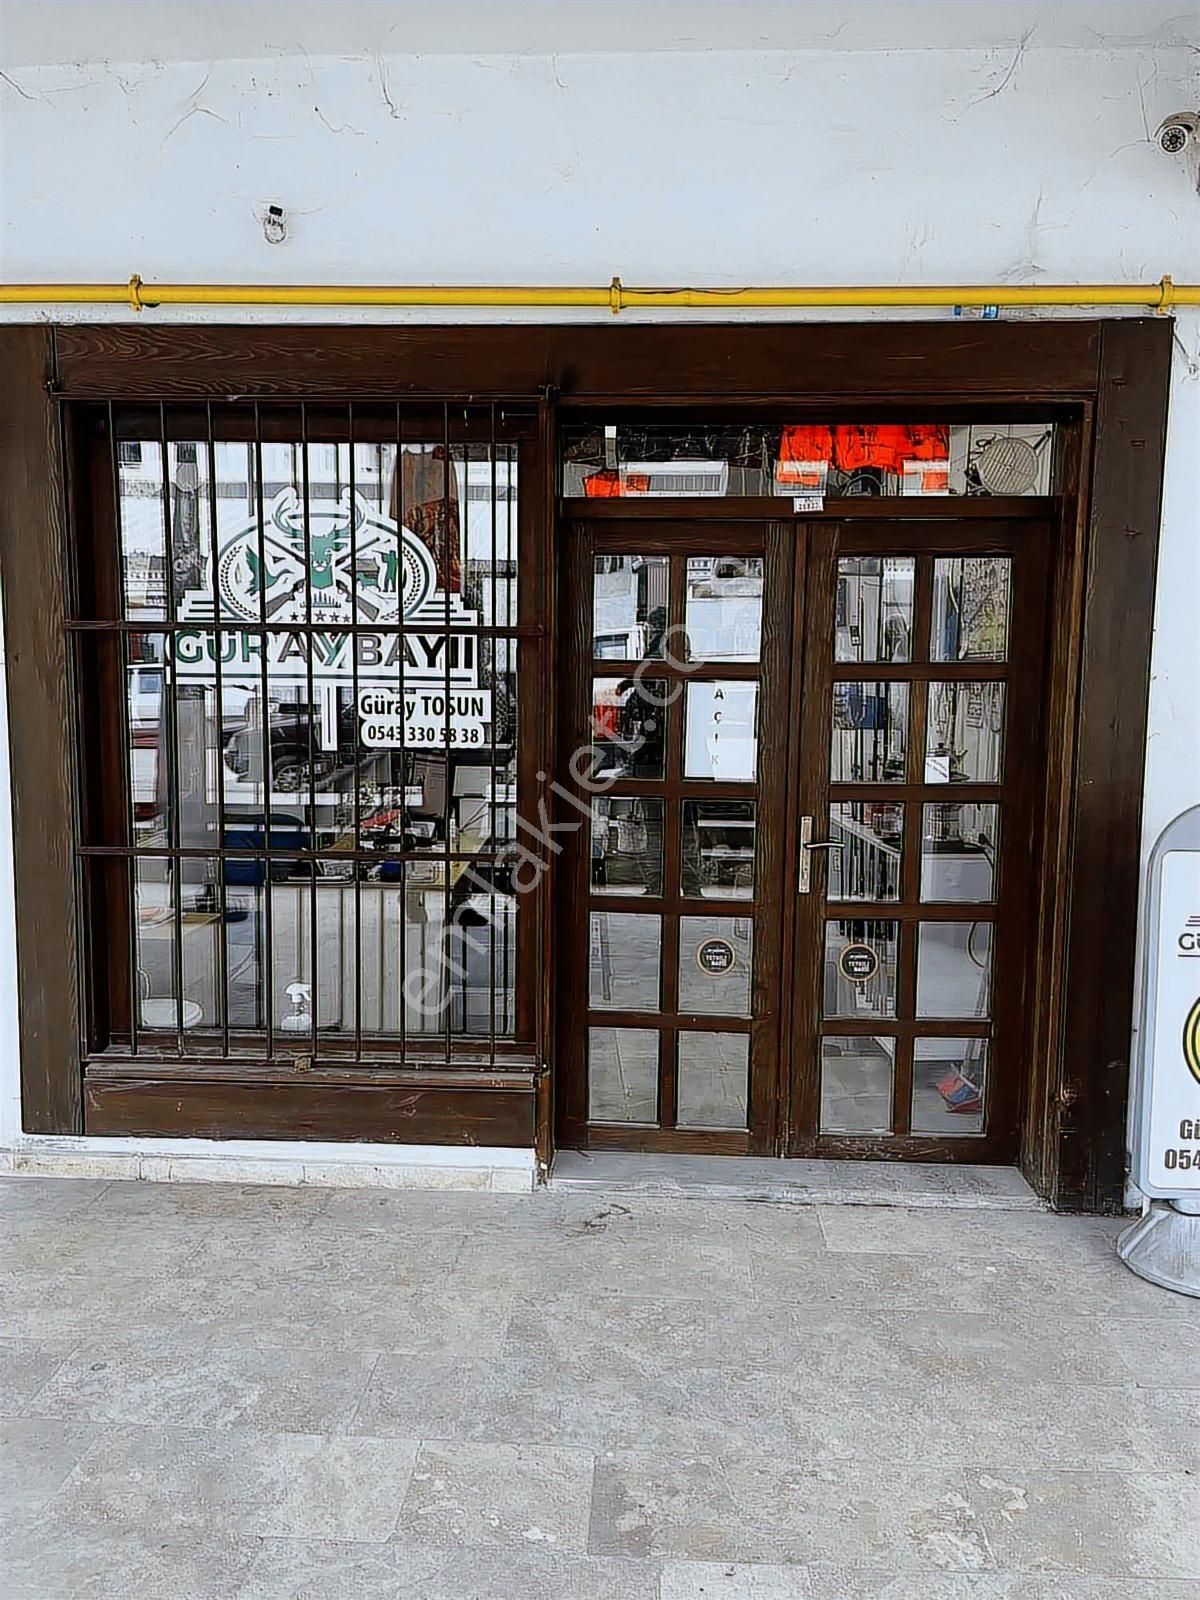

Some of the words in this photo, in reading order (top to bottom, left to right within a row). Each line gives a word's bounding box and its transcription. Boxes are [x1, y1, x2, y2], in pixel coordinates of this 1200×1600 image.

[360, 695, 416, 721] Güray
[421, 696, 484, 717] TOSUN
[367, 725, 402, 741] 0543
[408, 727, 435, 742] 330
[461, 728, 479, 743] 38
